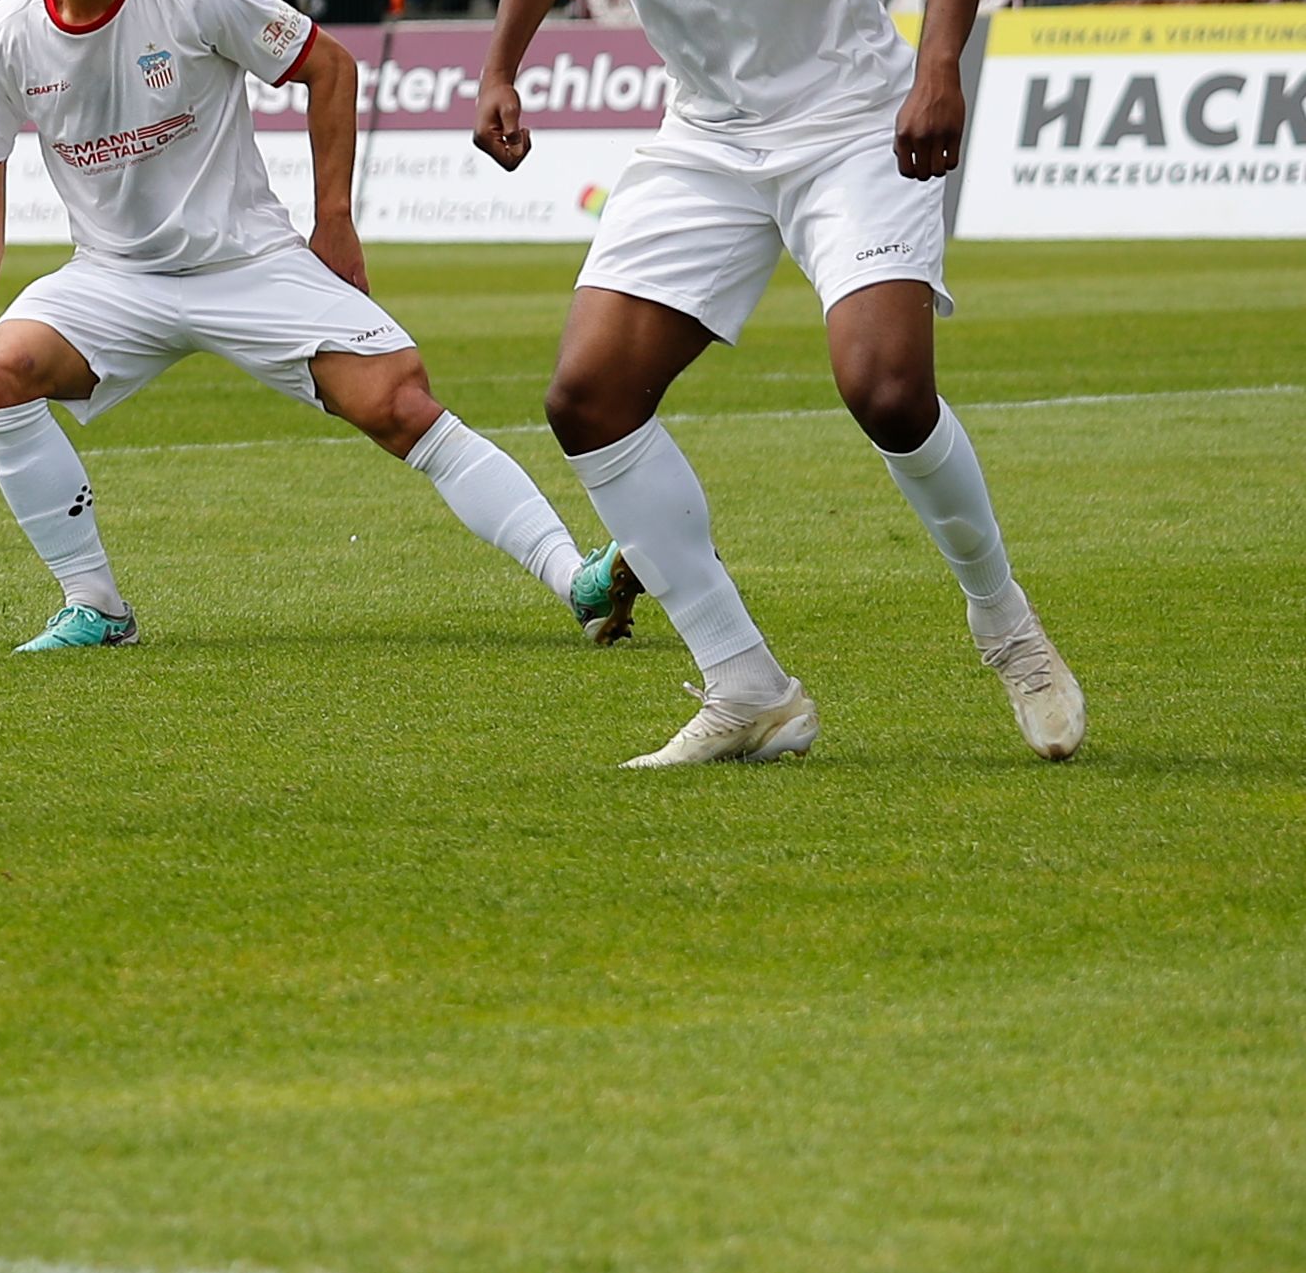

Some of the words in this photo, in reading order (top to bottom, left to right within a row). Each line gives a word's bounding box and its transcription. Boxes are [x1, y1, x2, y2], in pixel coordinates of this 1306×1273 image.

[26, 82, 59, 96] CRAFT
[76, 140, 155, 168] METALL
[364, 151, 450, 177] arkett
[855, 244, 900, 261] CRAFT
